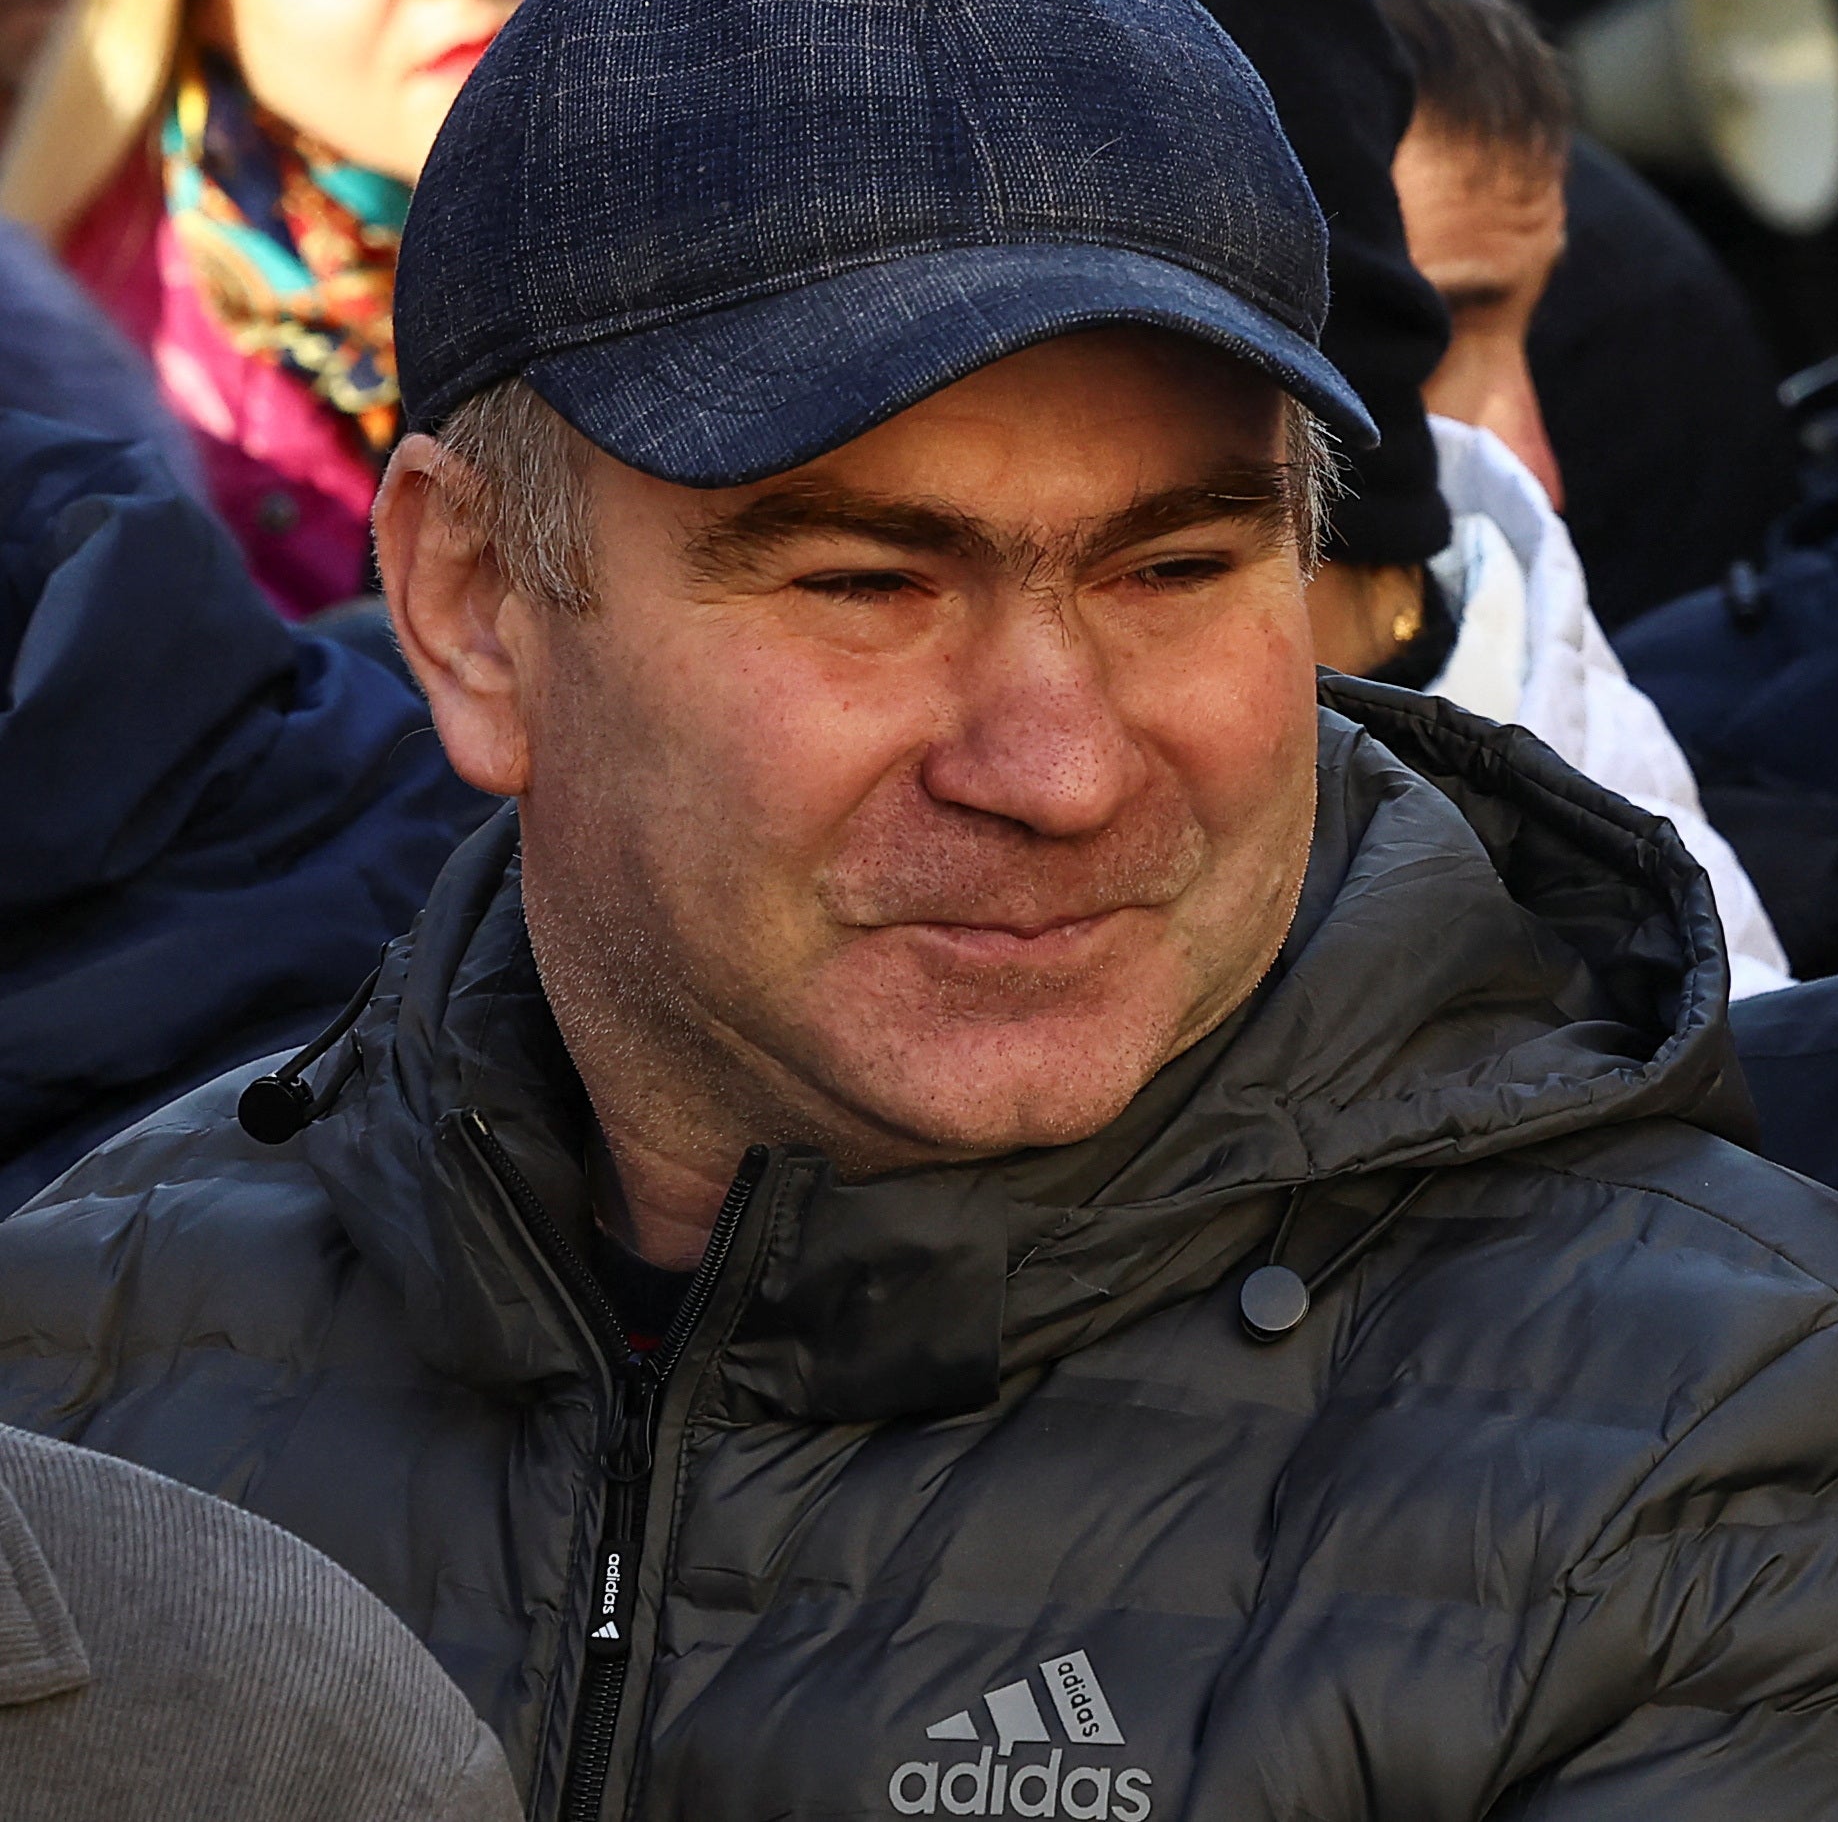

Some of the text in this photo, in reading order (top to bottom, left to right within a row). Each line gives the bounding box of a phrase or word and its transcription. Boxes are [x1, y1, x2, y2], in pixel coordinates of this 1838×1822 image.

[602, 1552, 621, 1615] adidas
[1056, 1661, 1100, 1738] adidas
[888, 1745, 1152, 1822] adidas
